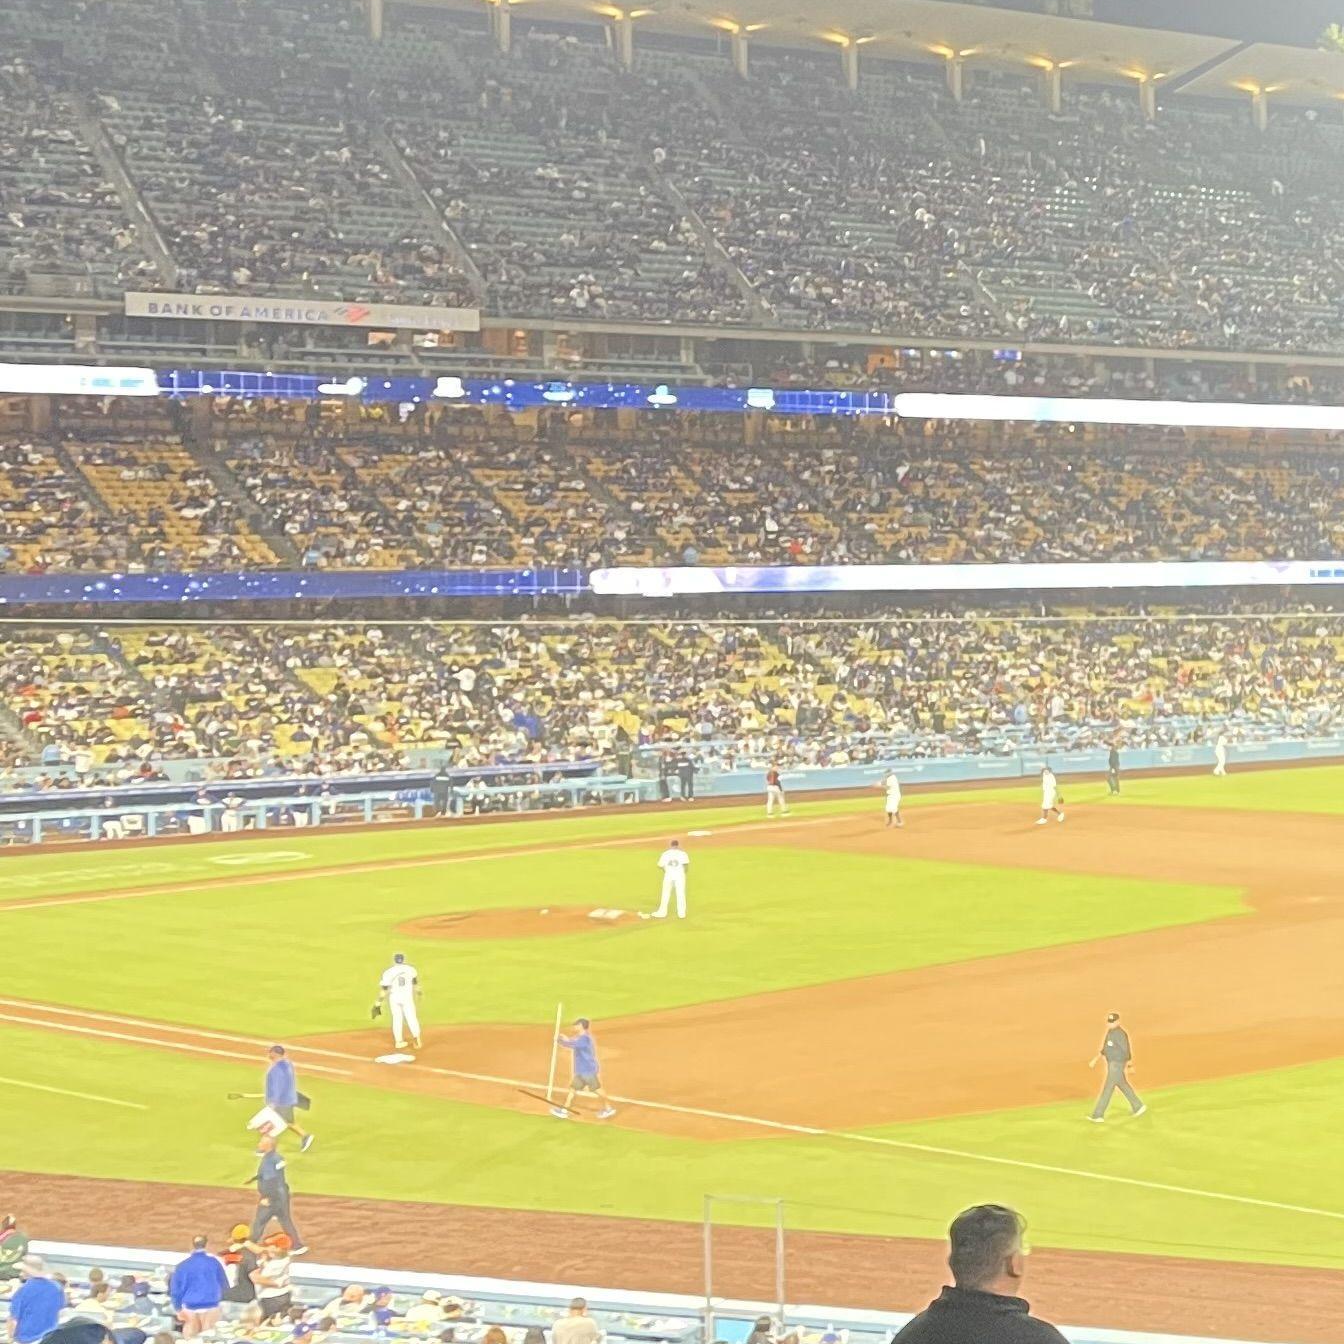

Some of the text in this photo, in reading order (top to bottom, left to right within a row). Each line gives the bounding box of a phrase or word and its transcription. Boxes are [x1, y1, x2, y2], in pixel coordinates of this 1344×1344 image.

[148, 302, 328, 322] BANK OF AMERICA
